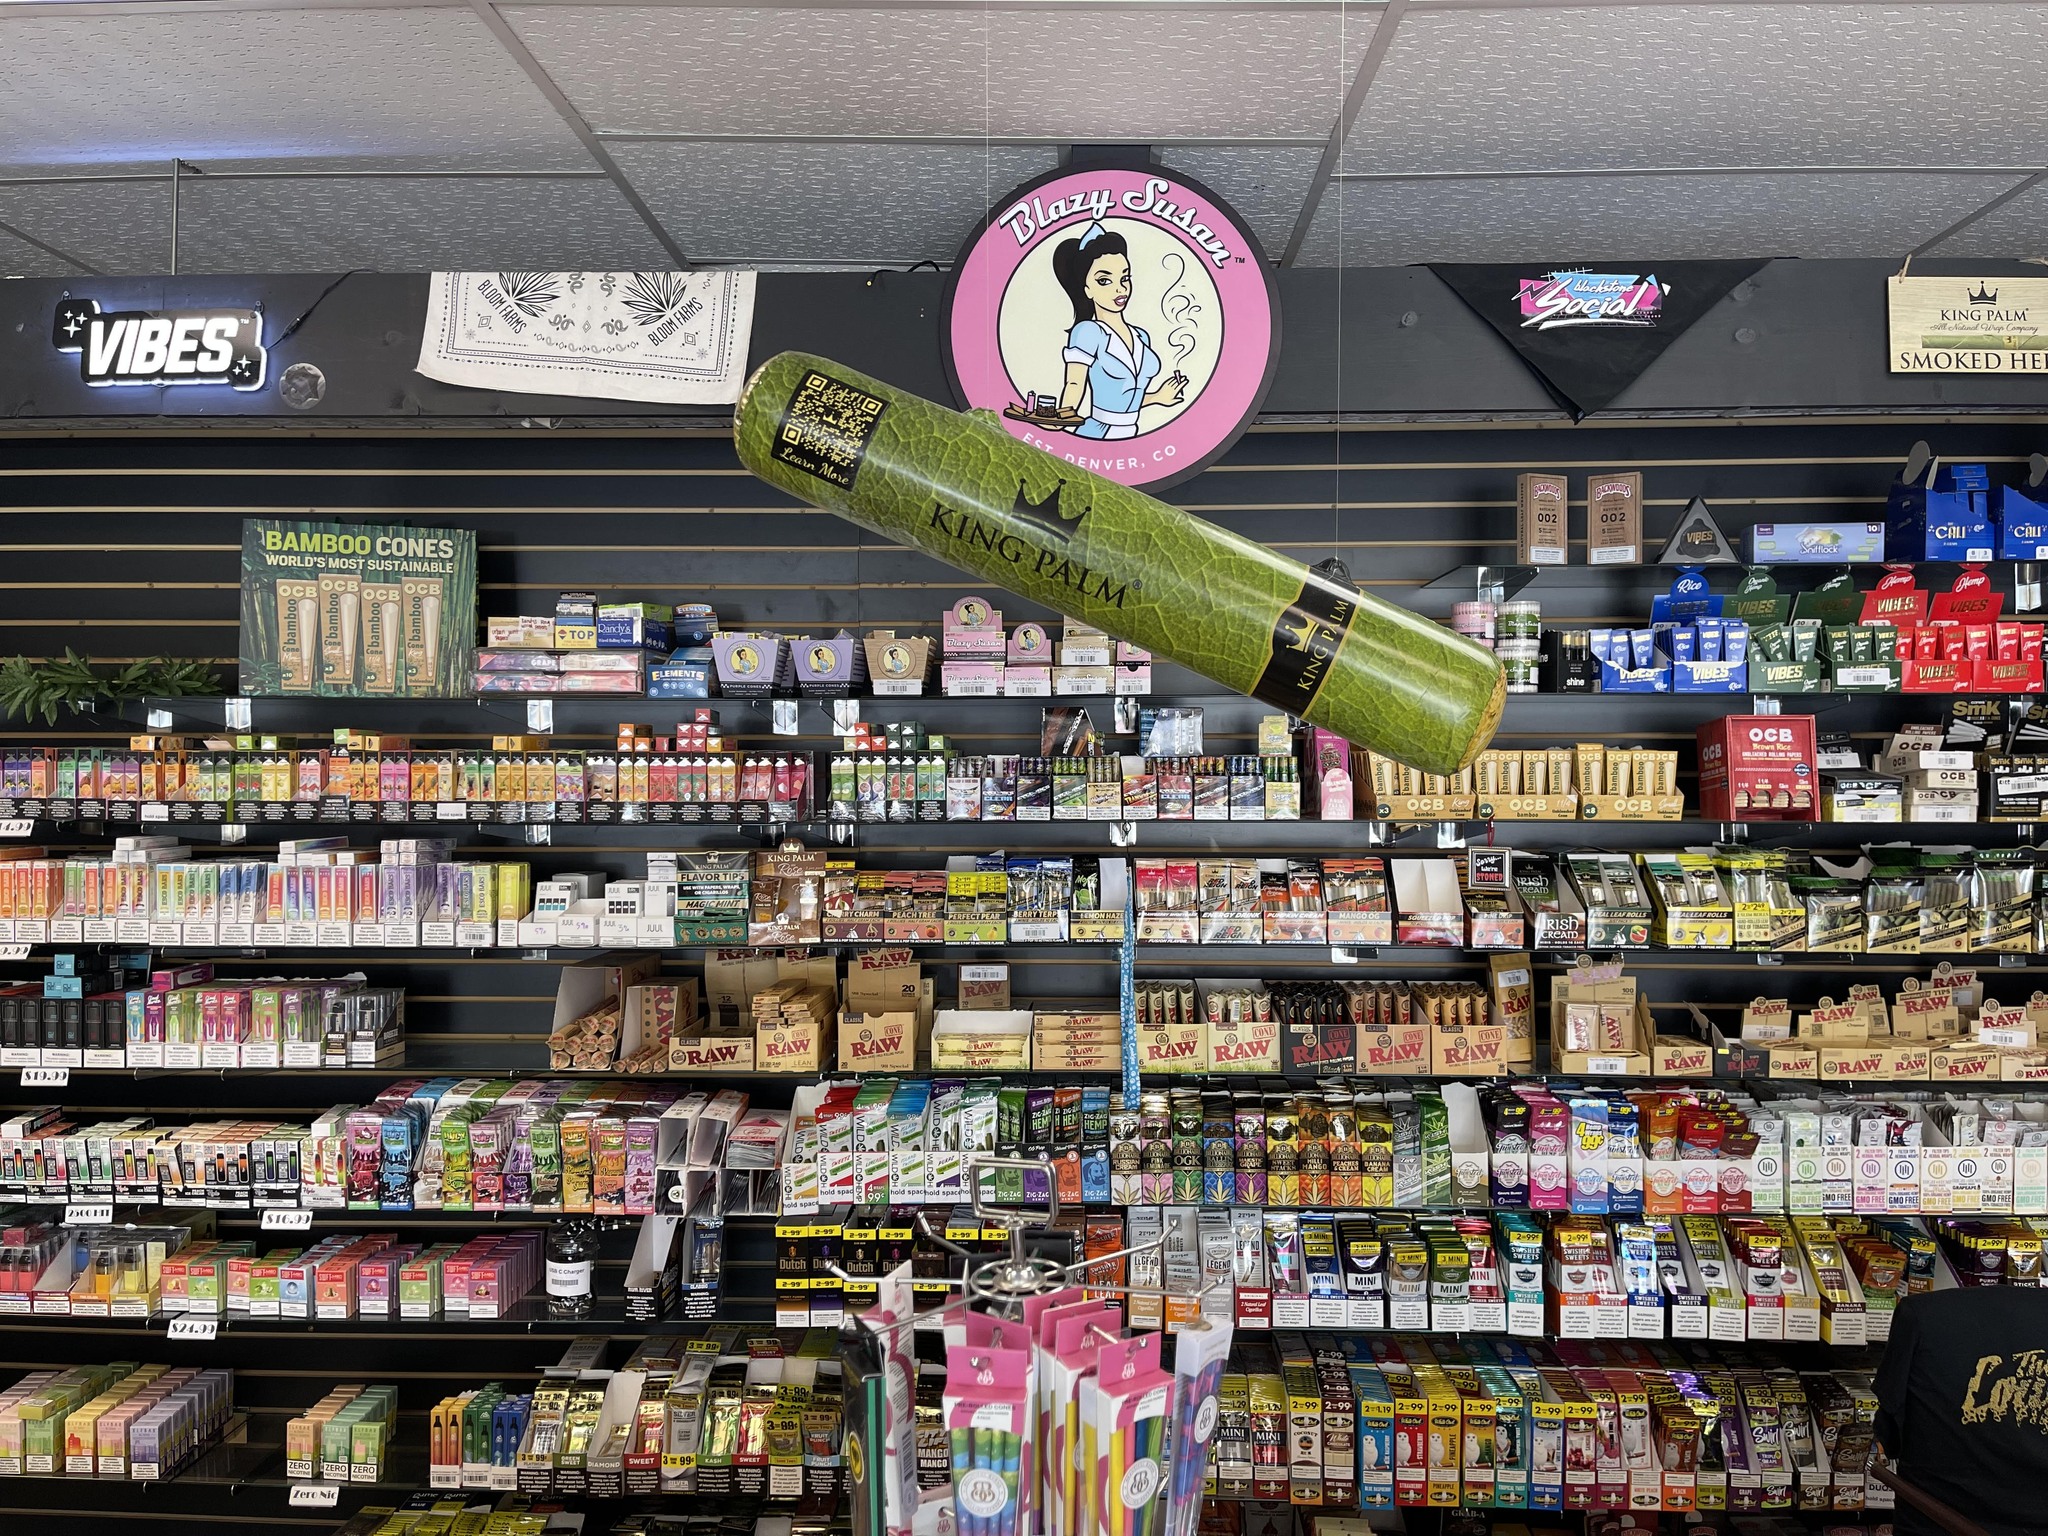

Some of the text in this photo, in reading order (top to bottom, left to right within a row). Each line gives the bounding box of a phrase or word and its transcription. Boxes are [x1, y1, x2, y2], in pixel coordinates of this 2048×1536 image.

[999, 178, 1231, 270] Blazy Susan
[1573, 279, 1634, 293] blackstone
[477, 278, 528, 335] BLOOM FARMS
[1520, 278, 1649, 327] Social
[647, 296, 704, 347] BLOOM FARMS
[1941, 309, 2027, 322] KING PALM
[1948, 323, 1979, 331] Natural
[2006, 323, 2039, 334] Company
[88, 317, 239, 375] VIBES
[1900, 352, 2048, 370] SMOKED HE
[1152, 444, 1176, 462] CO
[779, 446, 850, 485] Learn More
[1533, 482, 1562, 500] BACKWOODS
[1595, 482, 1632, 501] BACKWOODS
[1537, 513, 1558, 523] 002
[1600, 512, 1626, 523] 002
[1686, 530, 1713, 543] VIBES
[1935, 525, 1967, 540] CALI
[2013, 524, 2042, 538] CALI
[266, 530, 454, 559] BAMBOO CONES
[928, 502, 1128, 611] KING PALM
[265, 554, 454, 574] WORLD'S MOST SUSTAINABLE
[320, 579, 359, 592] OCB
[403, 582, 441, 595] OCB
[1677, 578, 1703, 594] Rice
[1881, 574, 1913, 591] Hemp
[1955, 575, 1985, 593] Hemp
[278, 584, 318, 598] OCB
[362, 588, 400, 601] OCB
[1876, 596, 1915, 612] VIBES
[284, 598, 297, 645] bamboo
[326, 592, 339, 640] bamboo
[409, 596, 422, 642] bamboo
[368, 601, 381, 649] bamboo
[597, 623, 633, 636] Randy's
[569, 629, 595, 640] TOP
[282, 645, 300, 653] Cone
[324, 639, 342, 647] Cone
[946, 638, 1002, 649] Blazy Susan
[1296, 599, 1349, 691] KING PALM
[530, 658, 557, 667] GRAPE
[651, 669, 706, 682] ELEMENTS
[1767, 665, 1804, 681] VIBES
[1919, 664, 1957, 679] VIBES
[1991, 664, 2029, 679] VIBES
[1566, 677, 1585, 686] shine
[1654, 682, 1668, 691] Rice
[1728, 682, 1743, 691] Rice
[1952, 700, 2001, 717] SmK
[1748, 727, 1794, 743] OCB
[1752, 743, 1792, 751] Brown Rice
[1613, 799, 1653, 813] OCB
[767, 853, 815, 863] KING PALM
[680, 872, 745, 882] FLAVOR TIPS
[1476, 872, 1504, 882] STONED
[685, 899, 740, 909] MAGIC MINT
[853, 910, 880, 918] CHARM
[948, 912, 1001, 921] PERFECT PEAR
[1201, 911, 1261, 919] ENERGY DRINK
[1338, 911, 1380, 920] MANGO OG
[646, 923, 664, 933] JUUL
[1542, 915, 1579, 930] IRISH
[1933, 923, 1950, 933] SLIM
[1541, 929, 1579, 939] CREAM
[901, 984, 916, 993] 20
[1904, 996, 1951, 1015] RAW
[844, 1016, 863, 1024] CLASSIC
[884, 1025, 902, 1036] CONE
[1181, 1031, 1198, 1039] CONE
[1253, 1026, 1275, 1037] CONE
[680, 1038, 700, 1046] CLASSIC
[1404, 1032, 1422, 1042] CONE
[1214, 1038, 1272, 1062] RAW
[1368, 1042, 1423, 1064] RAW
[1444, 1042, 1500, 1063] RAW
[1663, 1054, 1707, 1072] RAW
[1837, 1059, 1883, 1075] RAW
[24, 1070, 68, 1083] $19.99
[1083, 1119, 1108, 1131] HEMP
[1174, 1155, 1201, 1166] OGK
[1888, 1196, 1919, 1205] GMO FREE
[1981, 1194, 2012, 1203] GMO FREE
[67, 1209, 92, 1217] 2500
[266, 1212, 311, 1226] $16.99
[1511, 1246, 1540, 1254] SWISHER
[1513, 1252, 1540, 1260] SWEETS
[780, 1259, 806, 1270] Dutch
[847, 1262, 874, 1273] Dutch
[1206, 1259, 1231, 1270] LEGEND
[565, 1266, 585, 1276] Charger
[1312, 1275, 1335, 1286] MINI
[1439, 1284, 1463, 1295] MINI
[171, 1322, 216, 1335] $24.99
[1220, 1427, 1245, 1438] MINI
[1752, 1426, 1780, 1445] Swirl
[917, 1448, 950, 1459] MANGO
[287, 1460, 312, 1472] ZERO
[587, 1461, 621, 1469] DIAMOND
[628, 1457, 655, 1465] SWEET
[920, 1458, 948, 1469] MANGO
[352, 1464, 376, 1475] ZERO
[351, 1473, 377, 1481] NICOTINE
[292, 1488, 337, 1500] Zero Nic
[1672, 1487, 1687, 1495] PEACH
